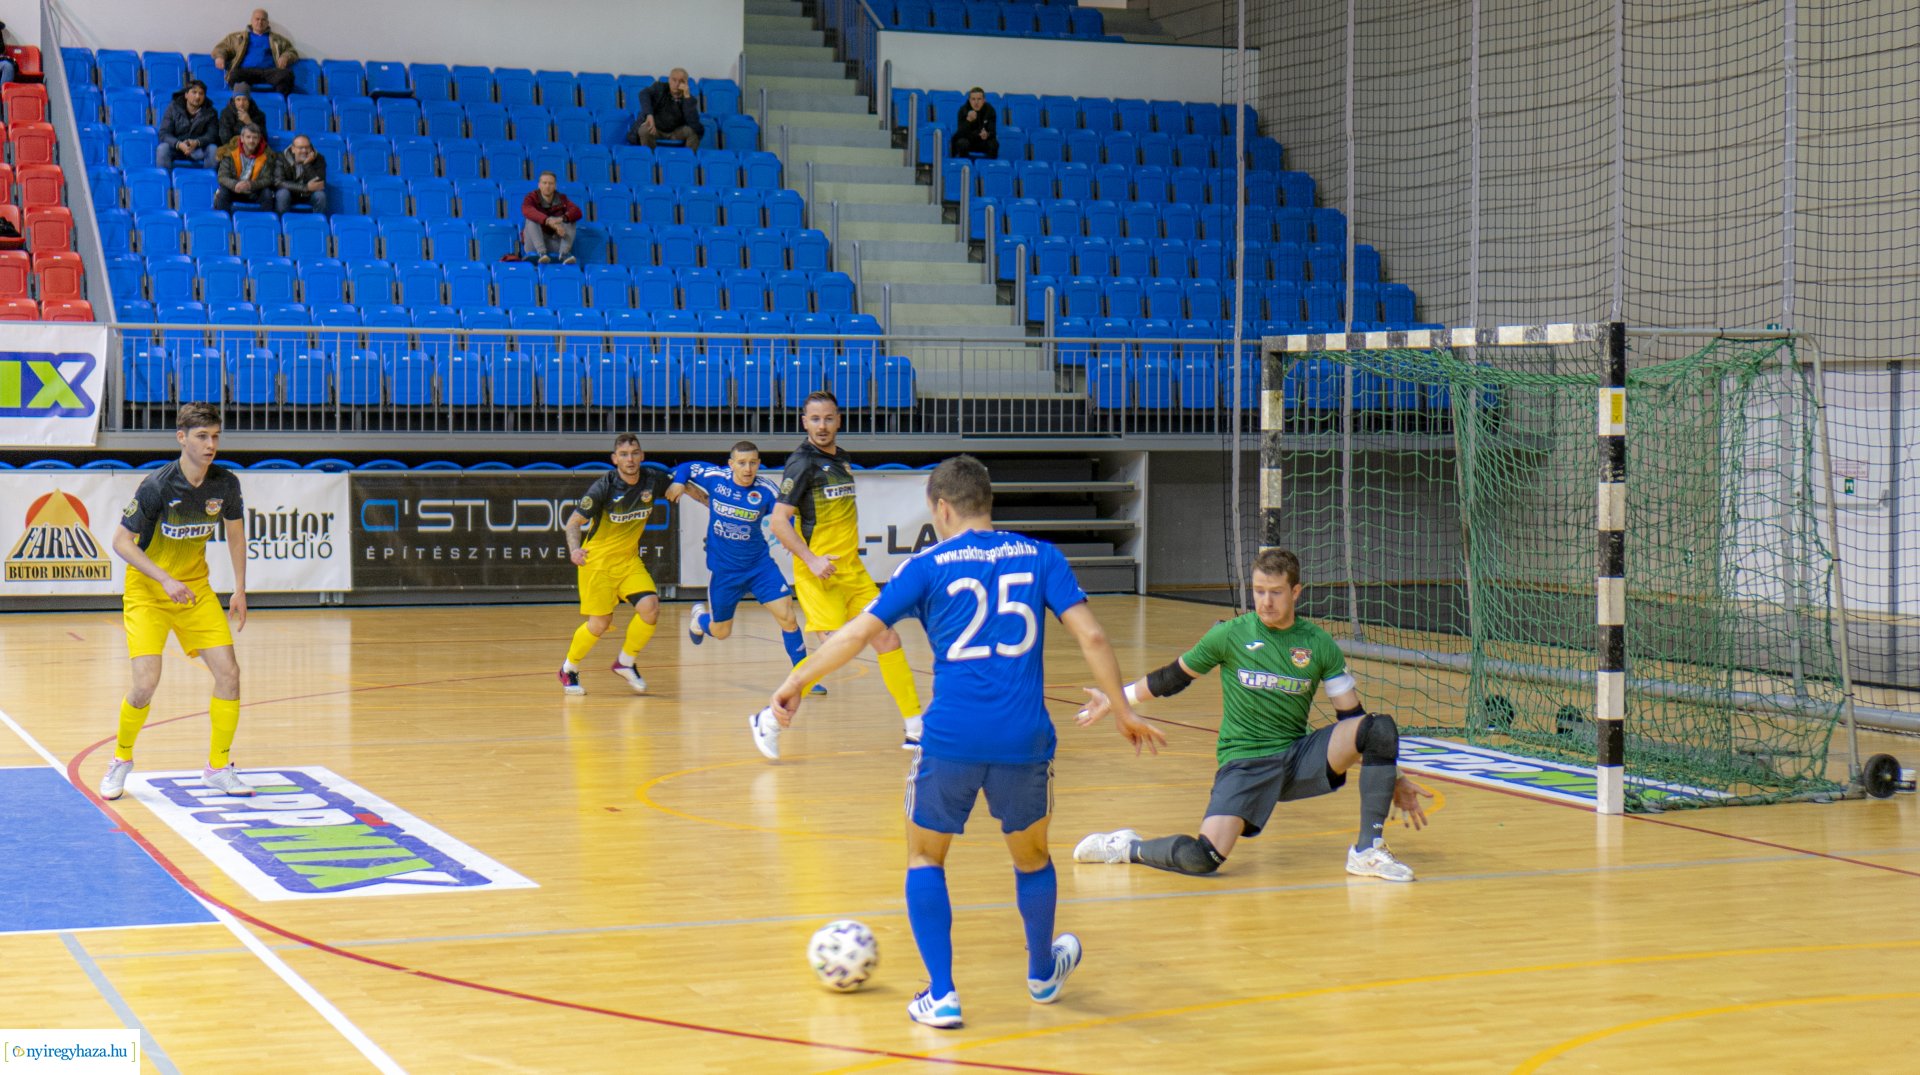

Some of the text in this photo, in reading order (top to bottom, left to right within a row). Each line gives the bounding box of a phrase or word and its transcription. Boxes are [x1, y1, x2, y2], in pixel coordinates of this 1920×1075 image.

[248, 506, 334, 542] bútor
[12, 523, 98, 559] FÁRAÓ
[248, 536, 333, 559] stúdió
[366, 545, 566, 560] ÉPÍTÉSZTERVE
[52, 565, 108, 579] DISZKONT
[947, 572, 1037, 661] 25
